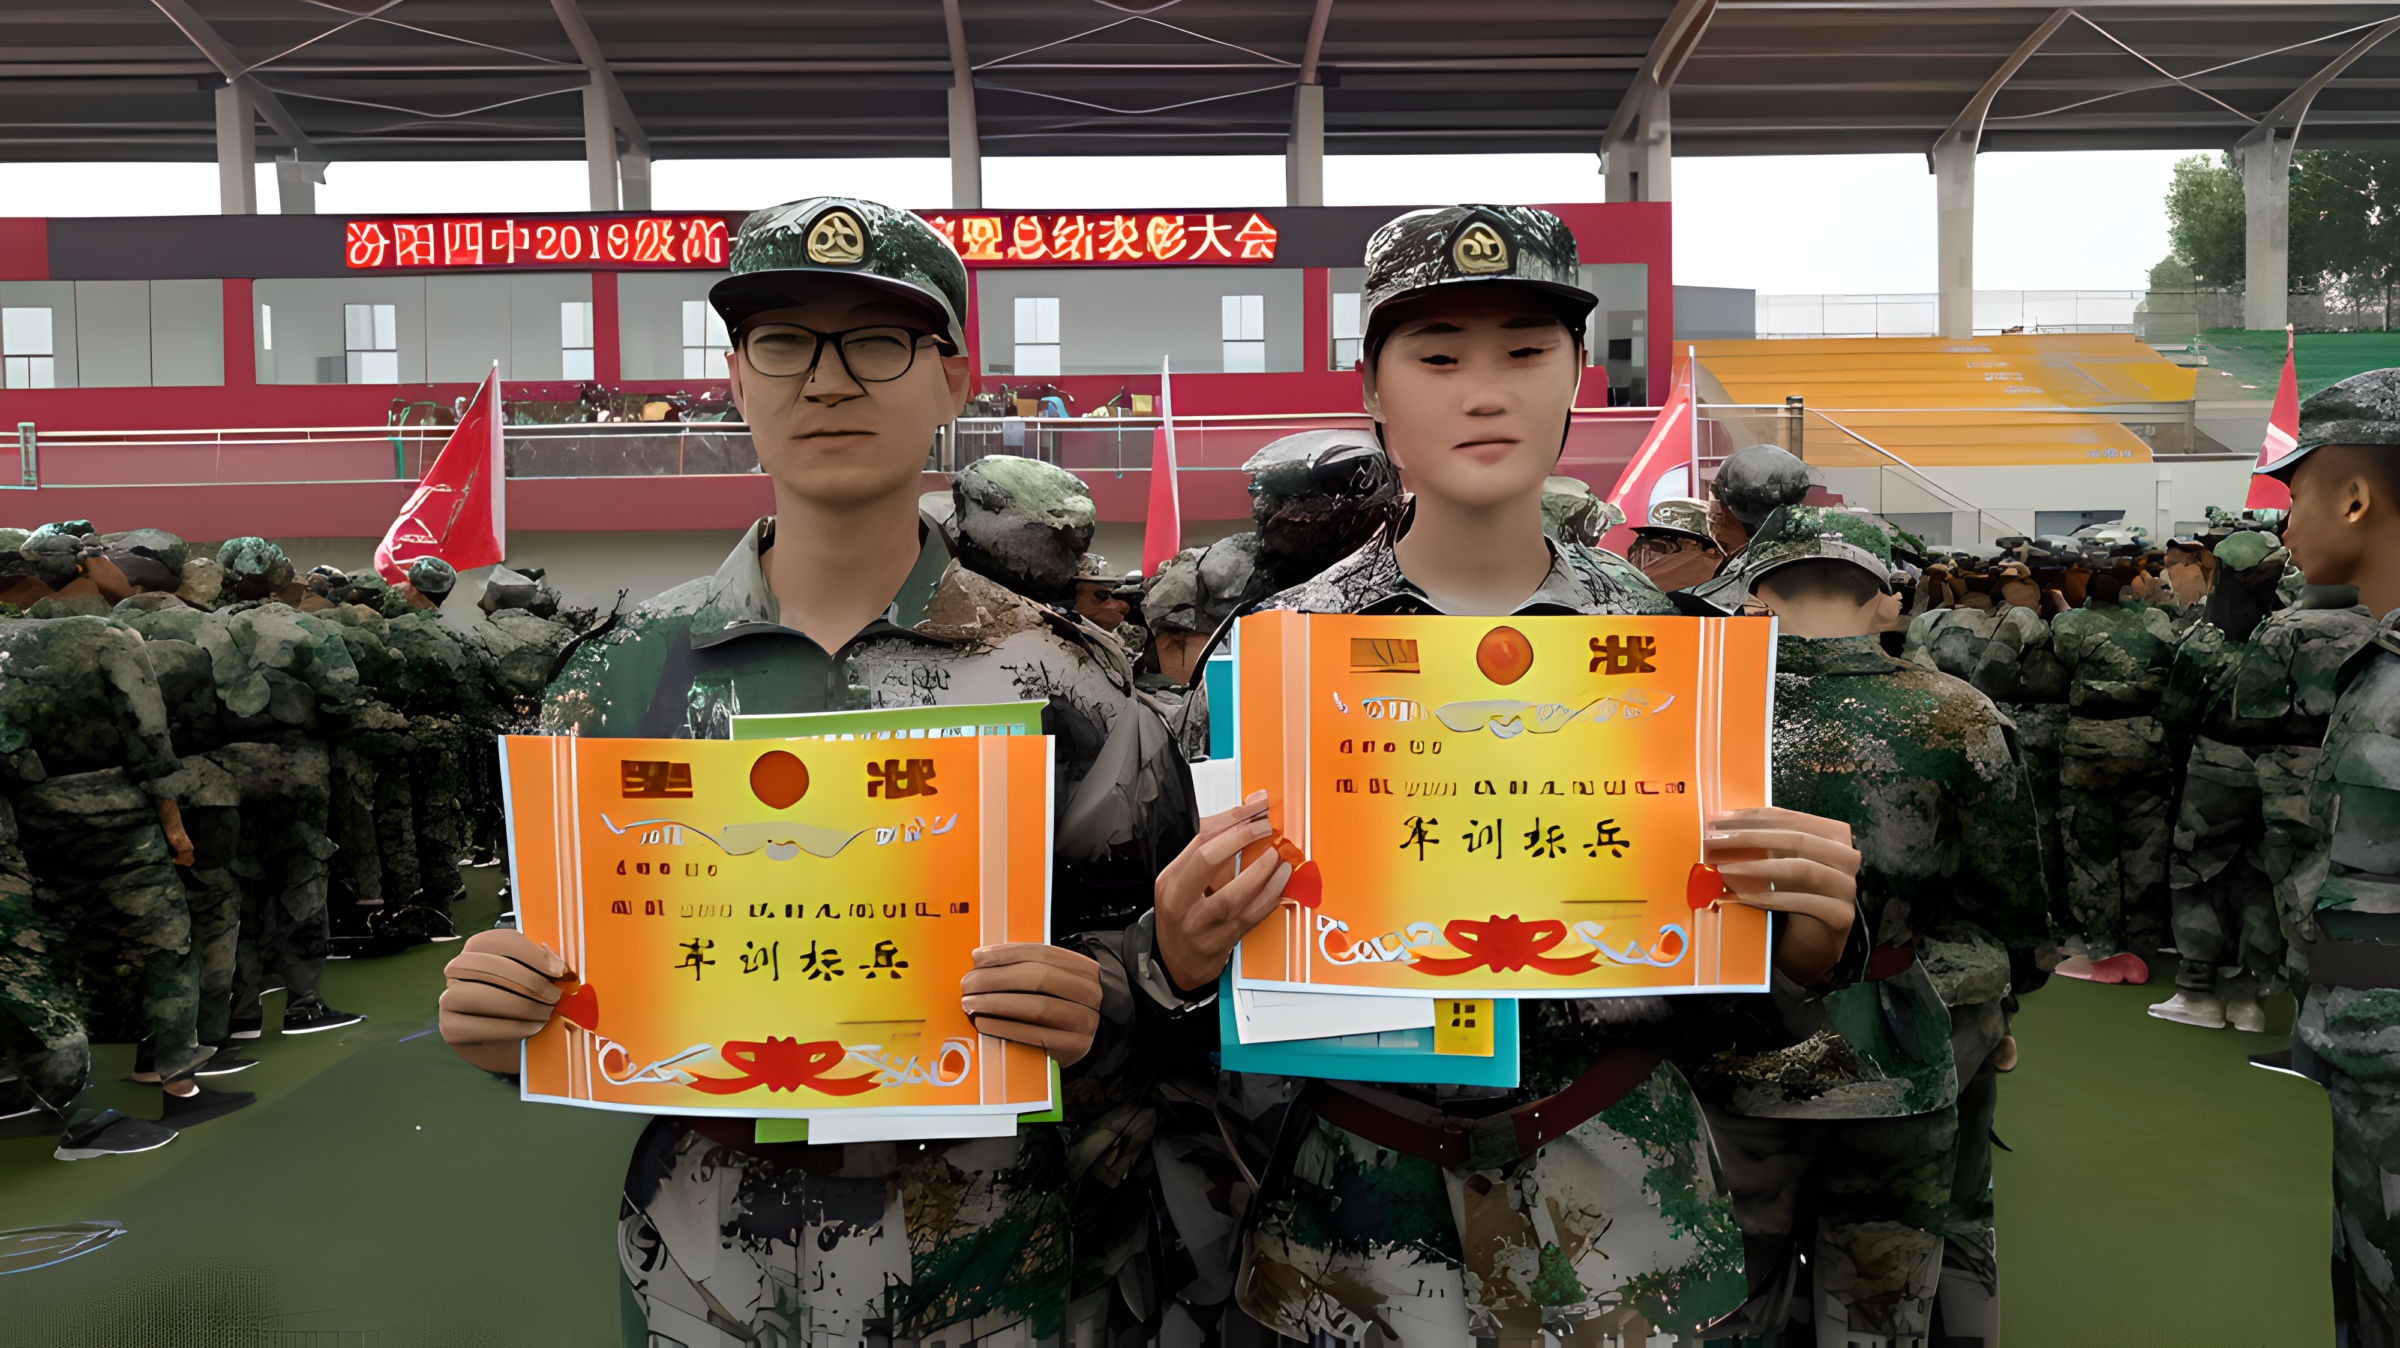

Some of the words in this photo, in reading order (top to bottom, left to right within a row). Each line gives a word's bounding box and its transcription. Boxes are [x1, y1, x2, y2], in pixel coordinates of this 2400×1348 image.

[1399, 815, 1630, 861] 军训标兵
[674, 937, 909, 981] 军训标兵
